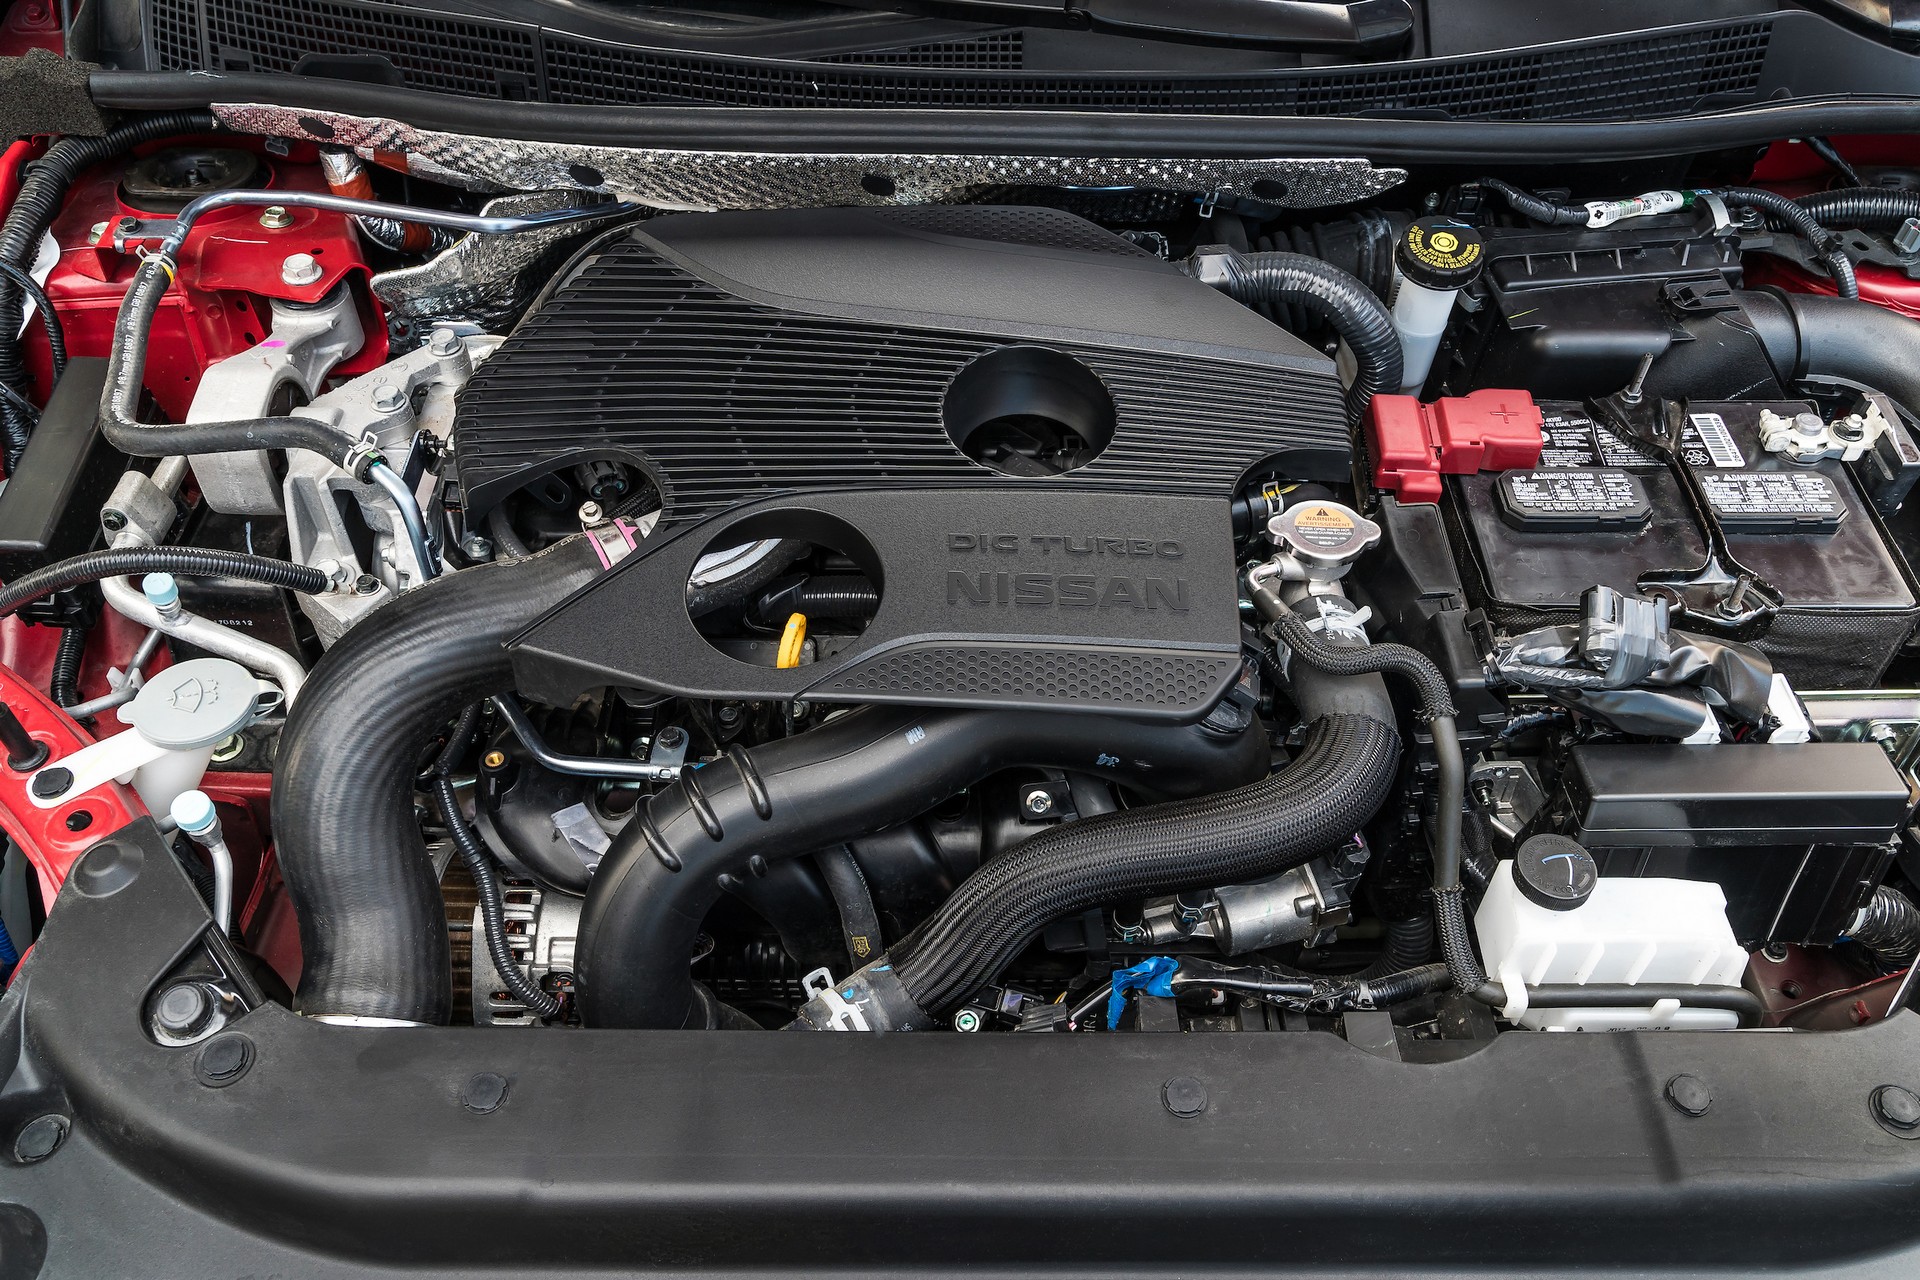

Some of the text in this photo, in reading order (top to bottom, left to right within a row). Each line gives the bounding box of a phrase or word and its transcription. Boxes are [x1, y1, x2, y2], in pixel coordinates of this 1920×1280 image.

[948, 534, 1184, 558] DIG TURBO
[948, 570, 1190, 610] NISSAN
